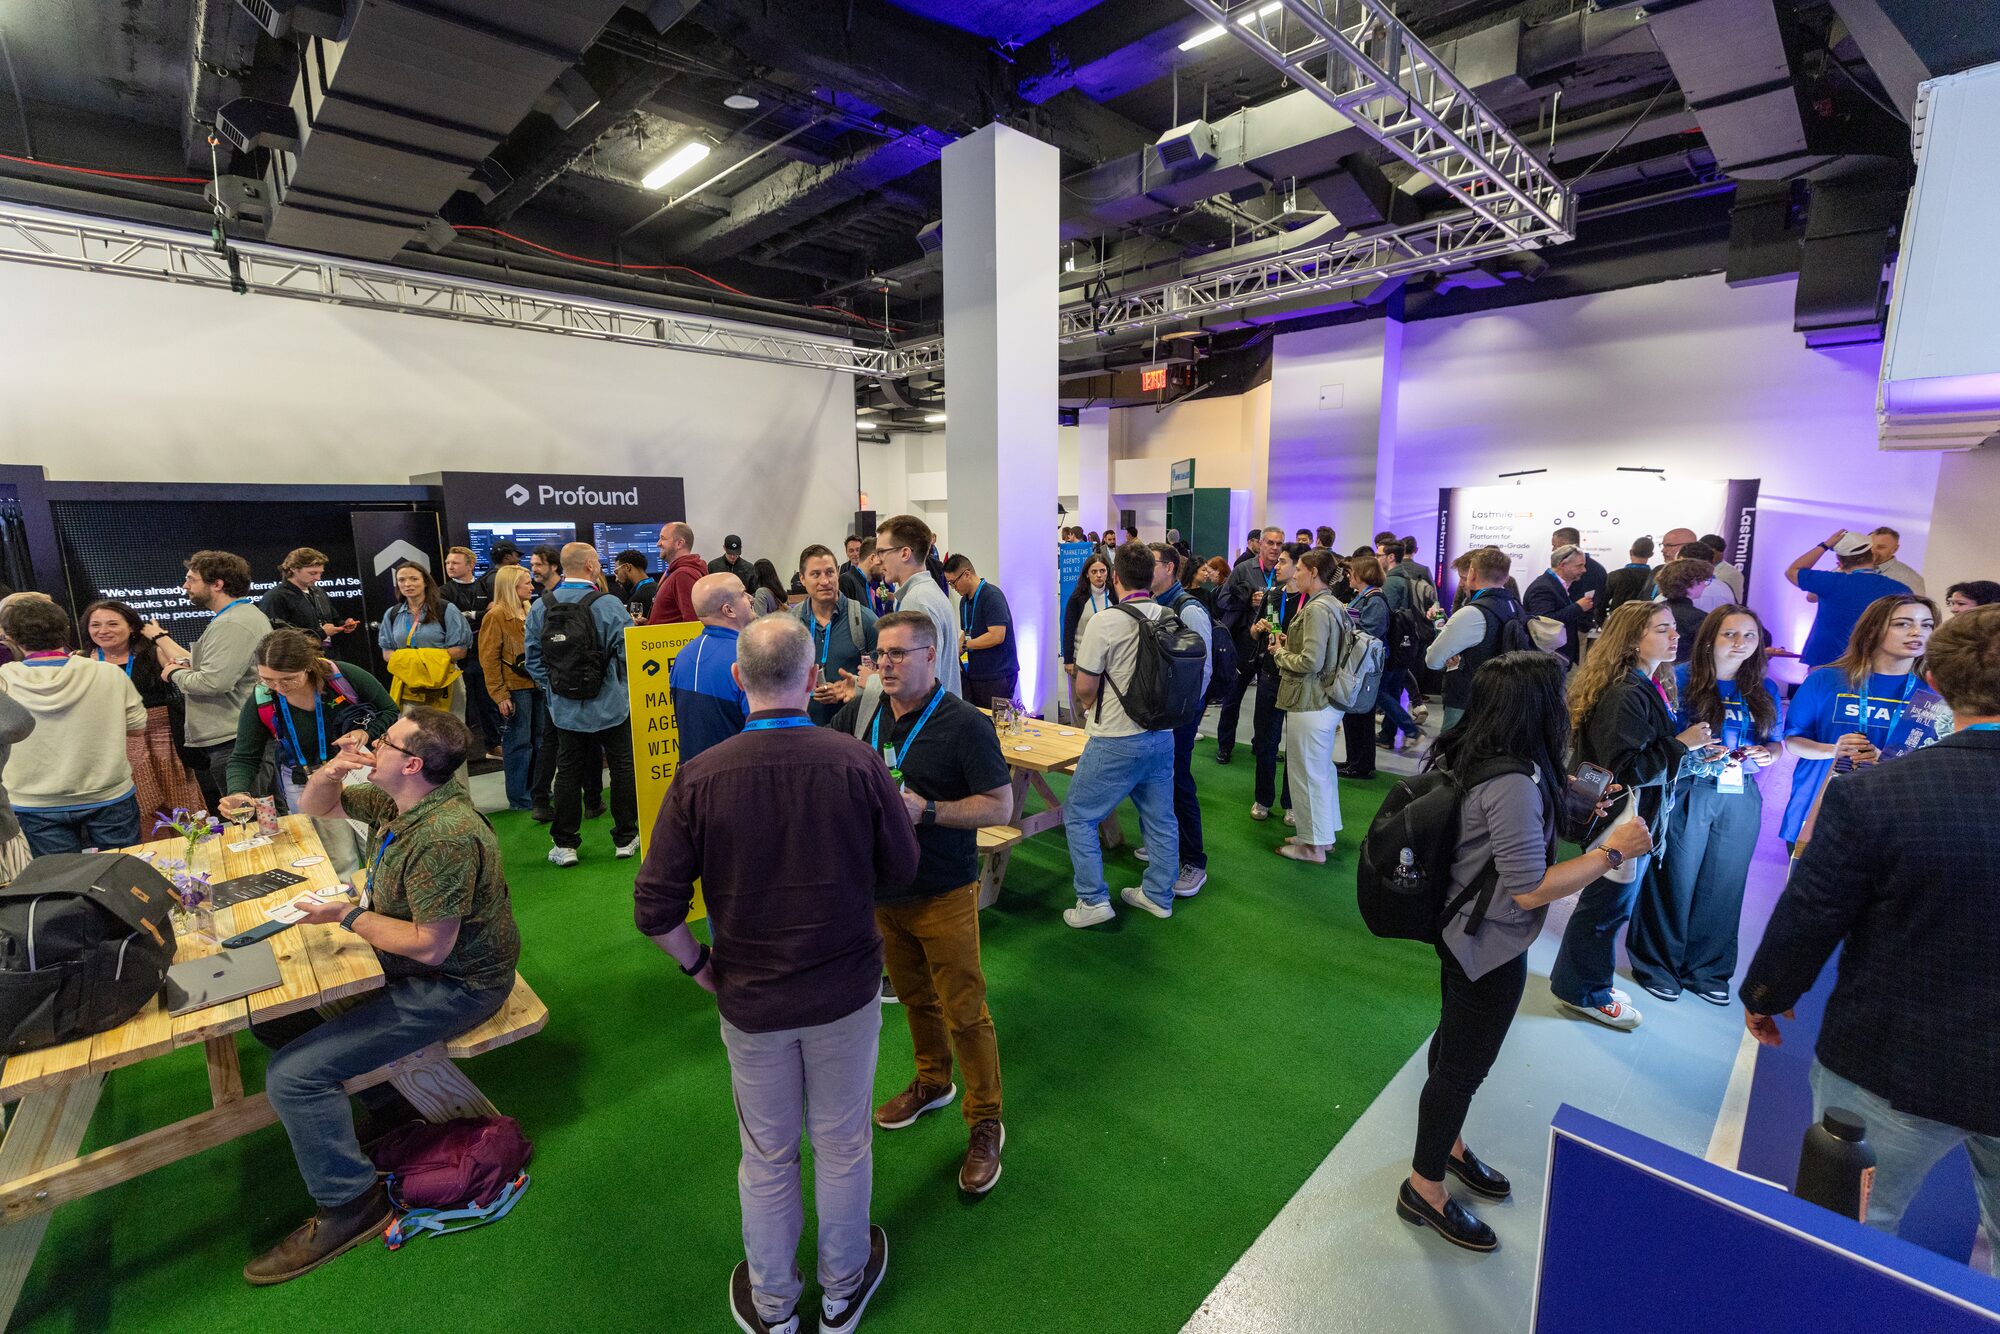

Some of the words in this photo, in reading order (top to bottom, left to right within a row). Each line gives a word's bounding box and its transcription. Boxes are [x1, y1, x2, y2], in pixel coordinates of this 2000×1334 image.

[1145, 369, 1165, 390] EXIT
[538, 485, 639, 505] Profound
[1472, 510, 1513, 518] Lastmile
[1439, 510, 1448, 562] Lastmile
[1734, 507, 1756, 572] Lastmile
[144, 586, 188, 596] already
[314, 579, 334, 587] rom
[335, 578, 346, 586] AI
[122, 600, 162, 609] hanks
[164, 598, 177, 607] to
[345, 589, 362, 599] got
[150, 612, 171, 620] the
[641, 638, 695, 651] Sponsor
